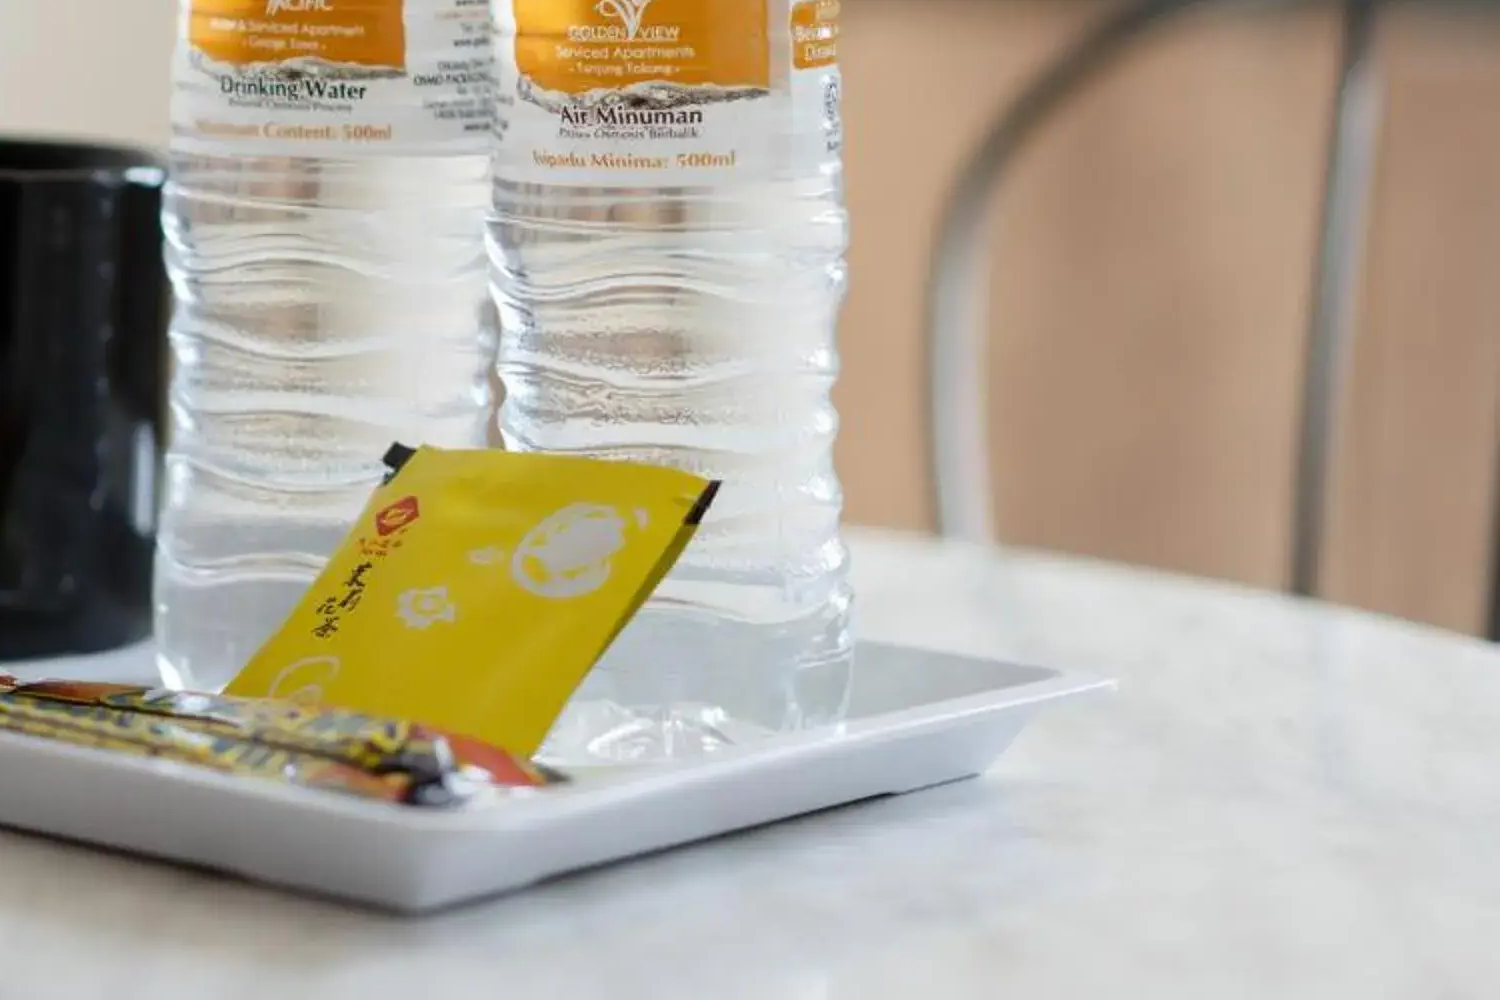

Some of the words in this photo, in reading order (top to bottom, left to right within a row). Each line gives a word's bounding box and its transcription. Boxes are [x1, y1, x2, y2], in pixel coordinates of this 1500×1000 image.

[568, 25, 626, 41] GOLDEN
[639, 26, 680, 40] VIEW
[555, 45, 608, 60] Serviced
[221, 75, 297, 101] Drinking
[306, 80, 367, 101] Water
[560, 106, 588, 125] Air
[596, 106, 703, 125] Minuman
[342, 125, 391, 141] 500ml
[677, 151, 736, 168] 500ml
